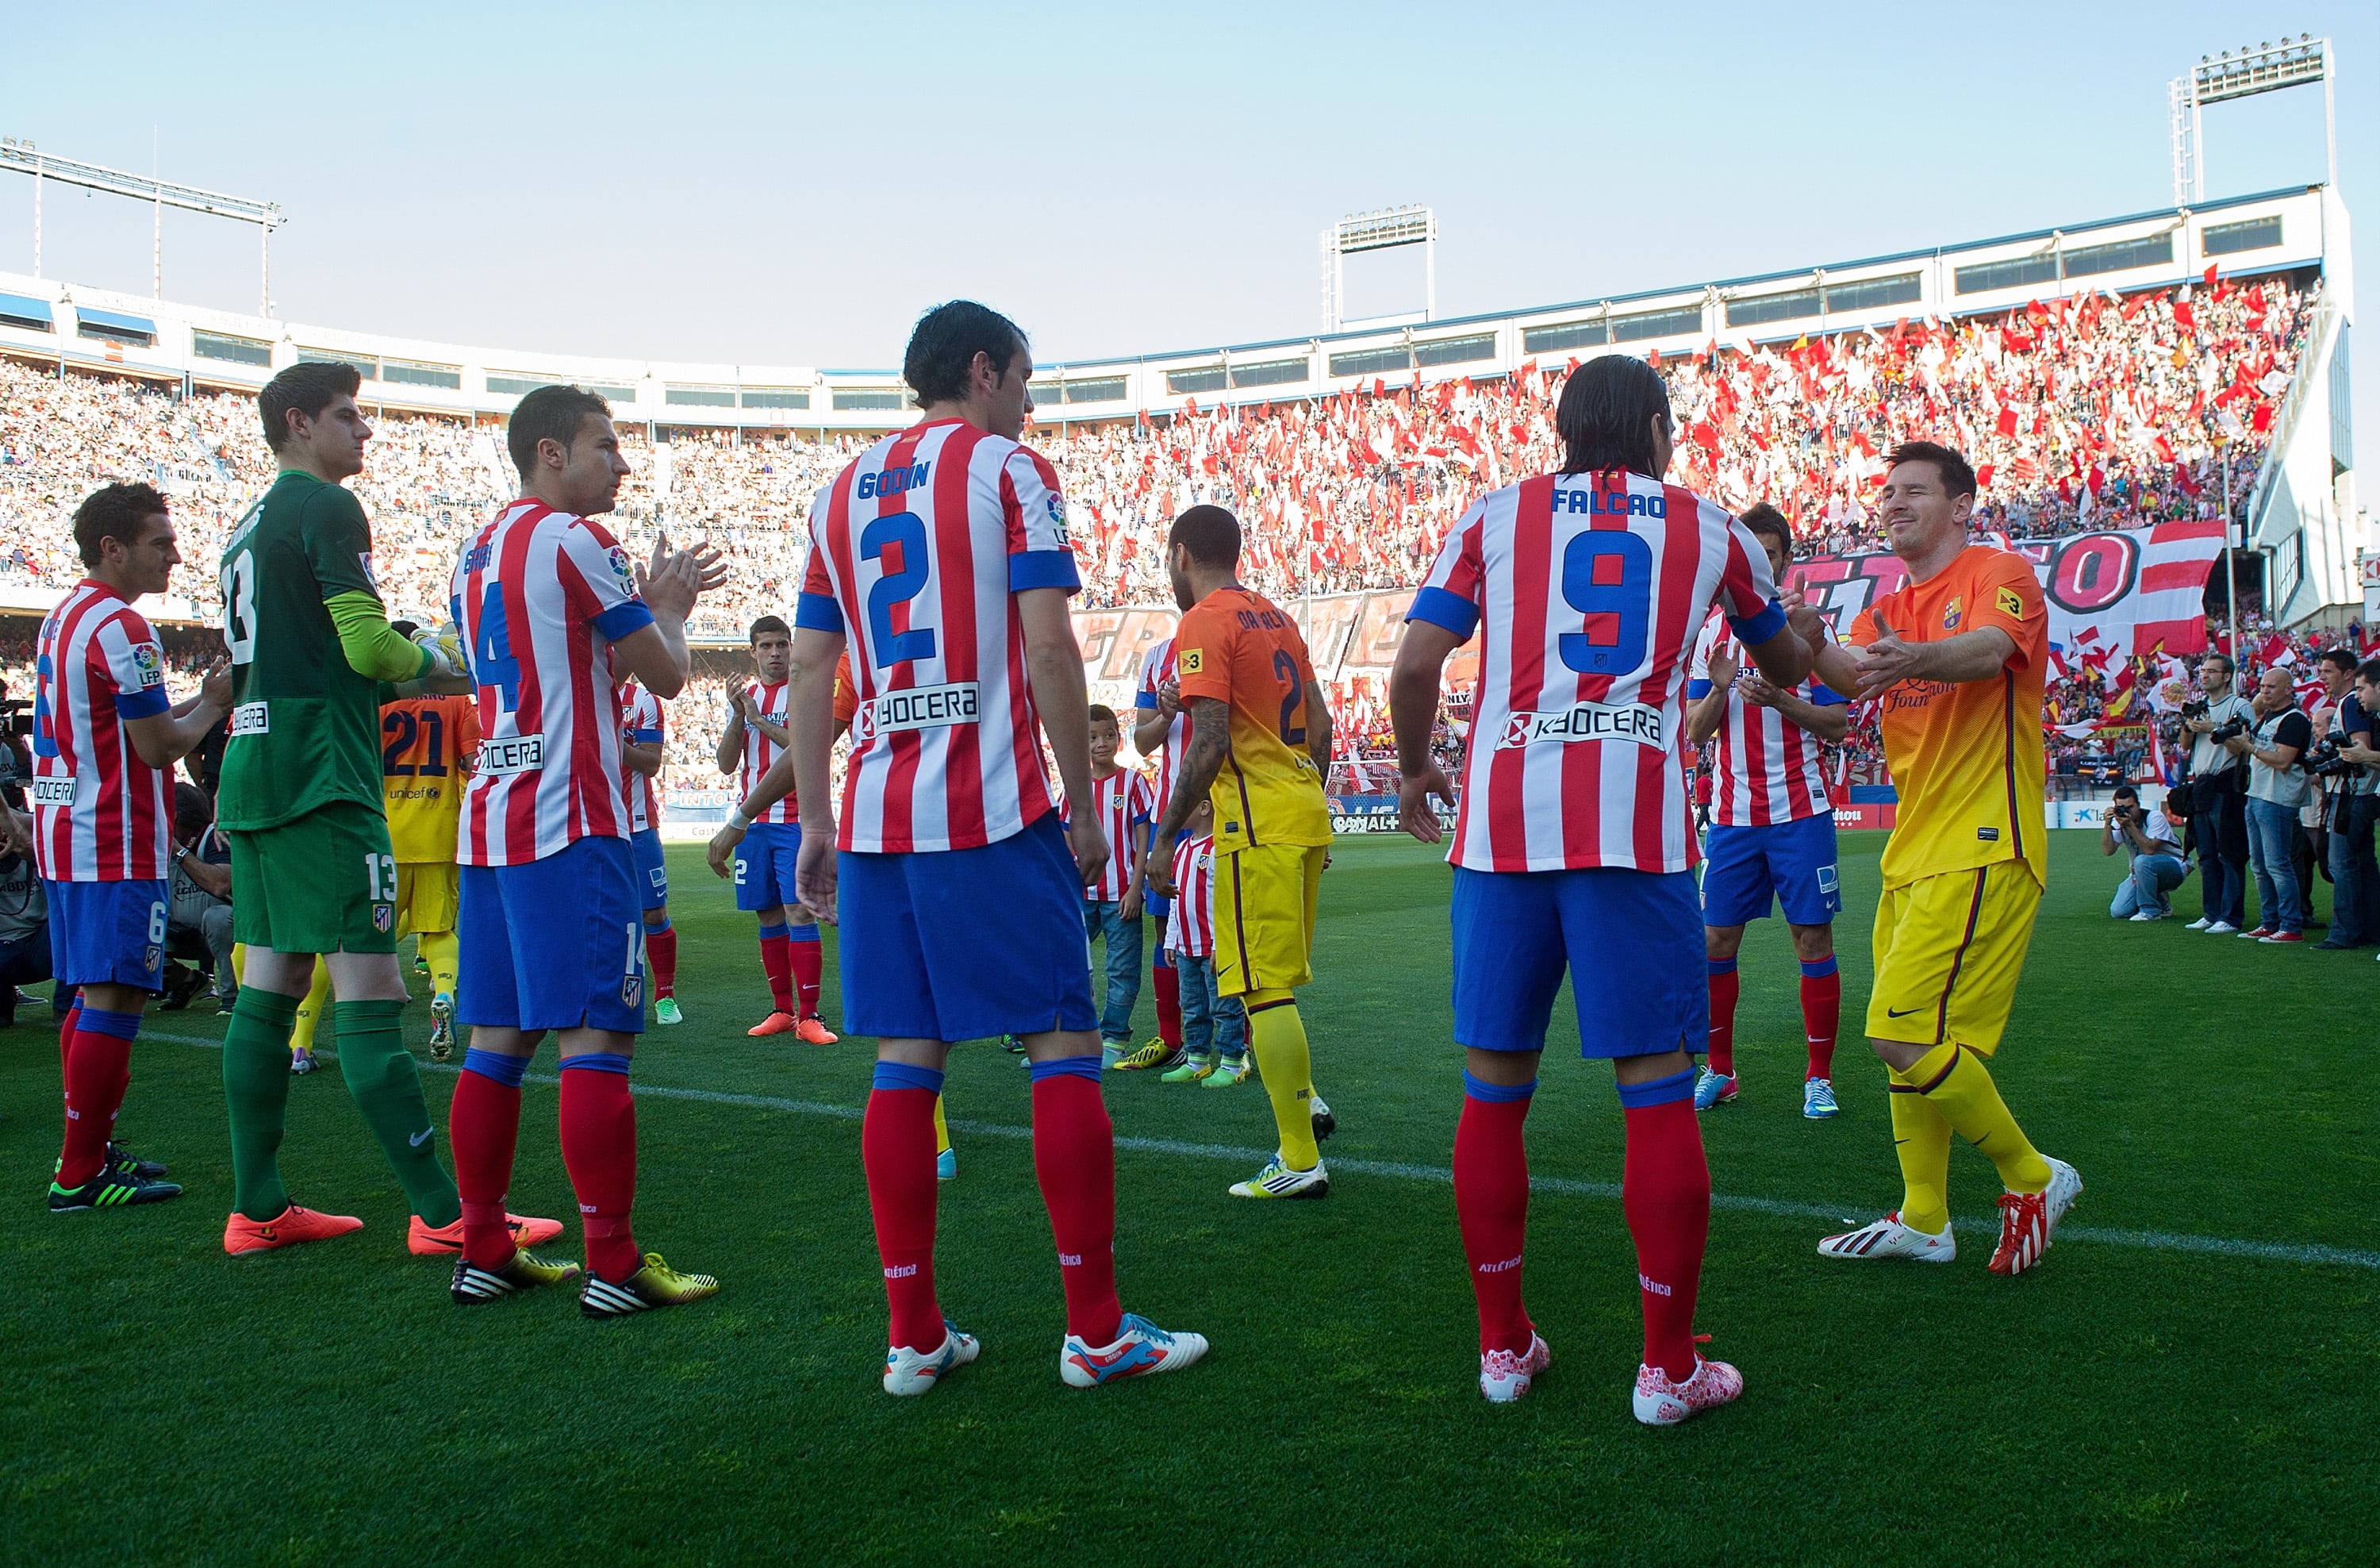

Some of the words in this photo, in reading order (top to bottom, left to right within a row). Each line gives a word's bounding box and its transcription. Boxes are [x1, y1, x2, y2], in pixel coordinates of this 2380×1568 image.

[858, 457, 931, 500] GODÍN
[1551, 488, 1668, 520] FALCAO
[860, 510, 937, 671] 2
[1558, 528, 1653, 677] 9
[2008, 597, 2021, 615] 3
[139, 670, 161, 686] LFP
[1189, 653, 1200, 669] 3
[33, 653, 60, 758] 6
[1273, 648, 1306, 746] 2
[1445, 694, 1469, 704] NLY
[383, 709, 448, 778] 21
[390, 786, 426, 800] unicef
[665, 792, 726, 808] PINTO
[365, 852, 398, 901] 13
[148, 901, 167, 944] 6
[1478, 1254, 1522, 1274] ATLÉTICO
